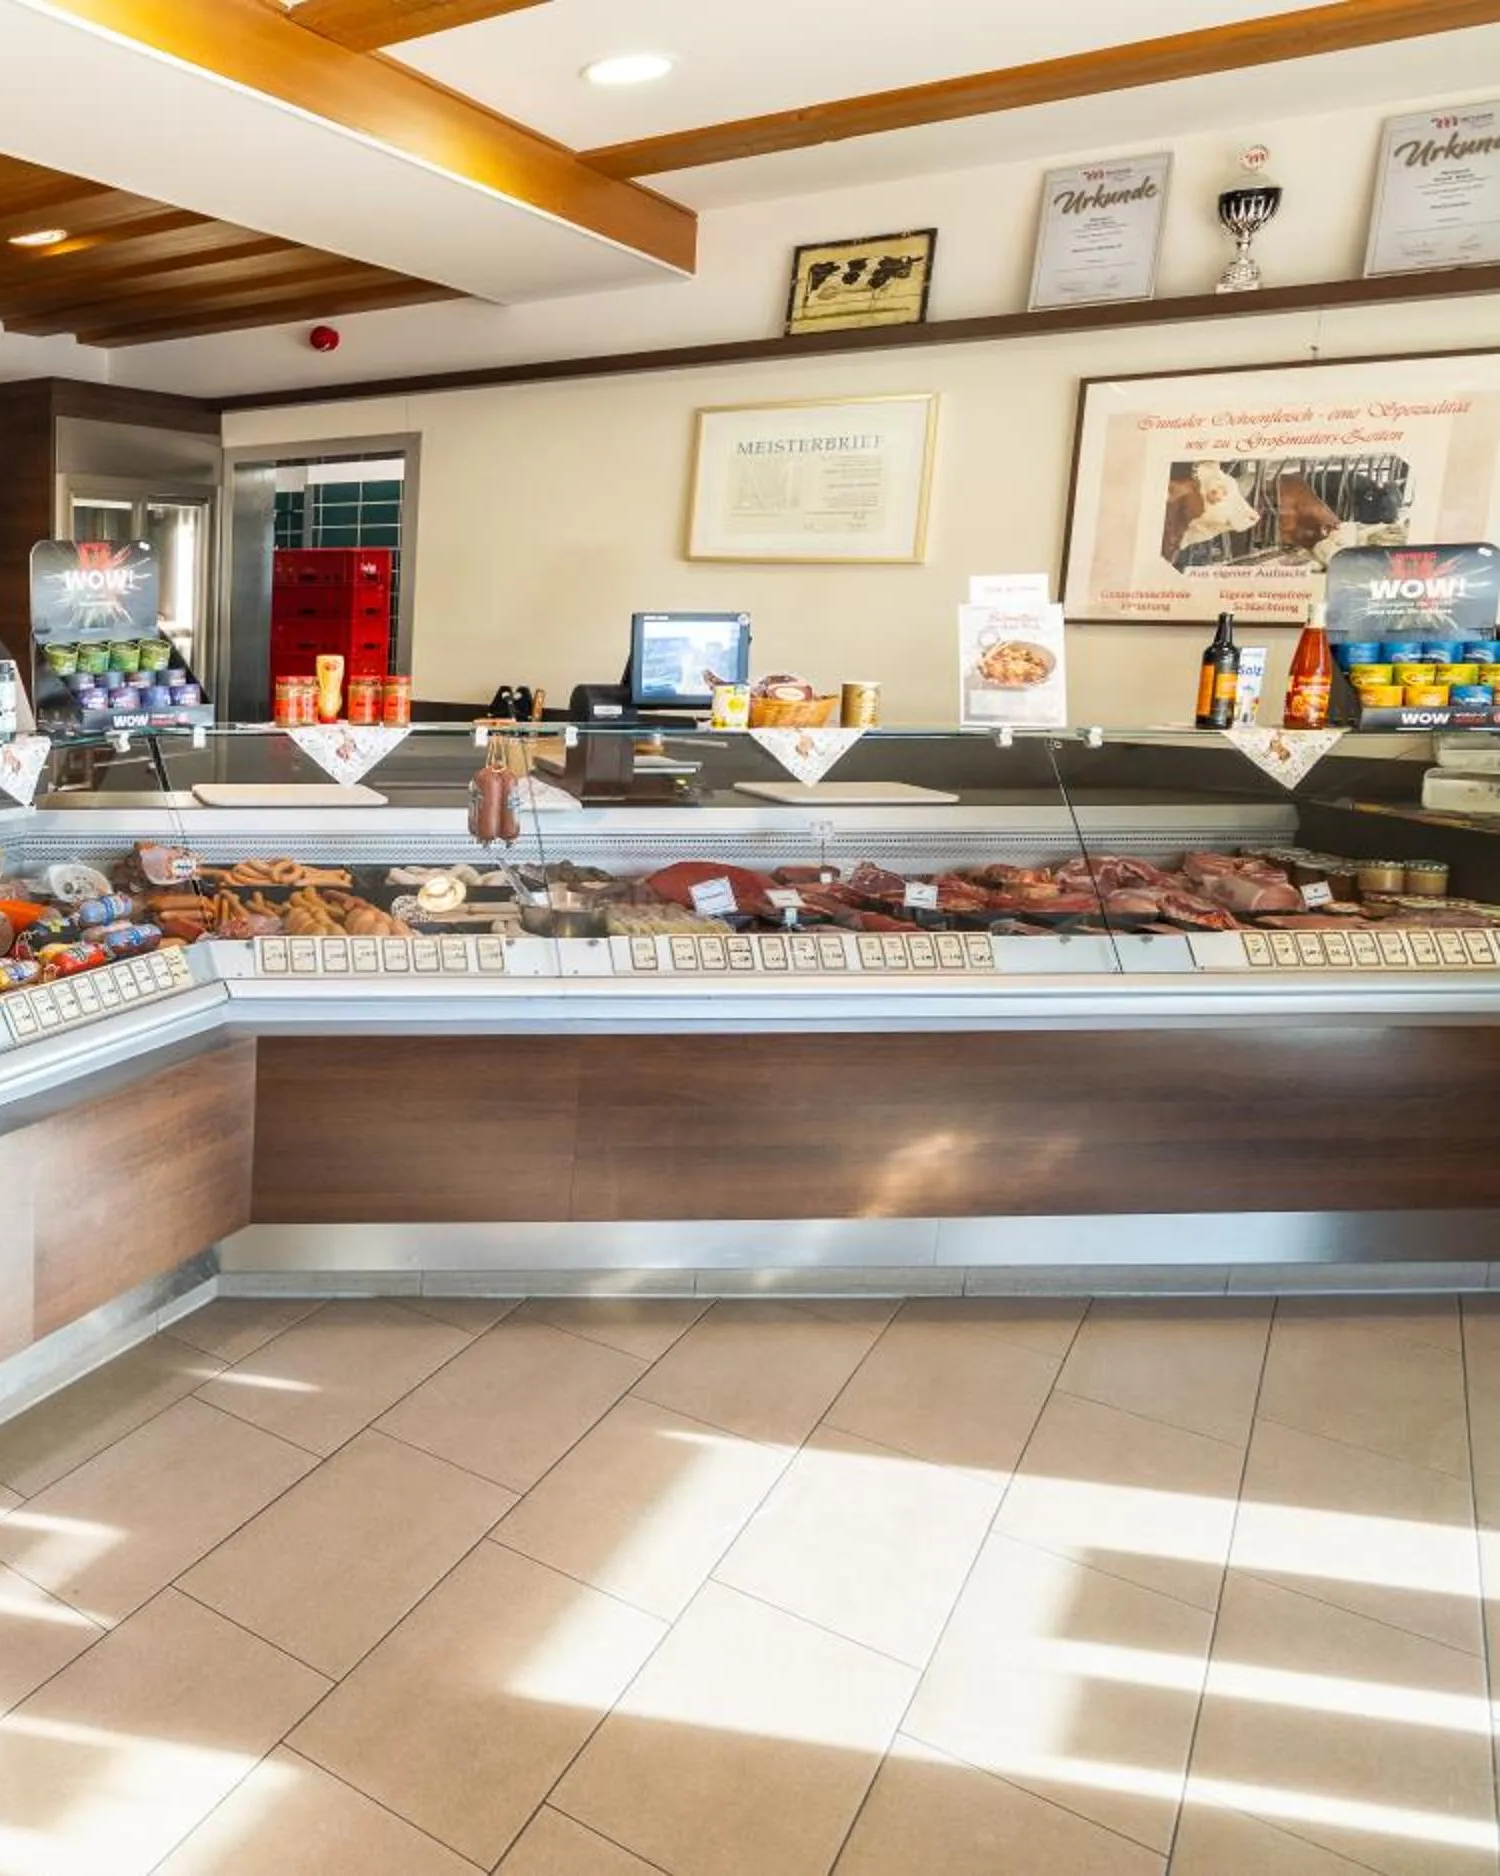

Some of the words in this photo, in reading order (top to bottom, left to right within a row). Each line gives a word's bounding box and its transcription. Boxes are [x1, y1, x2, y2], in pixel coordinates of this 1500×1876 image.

[1393, 131, 1500, 167] Urkun
[1053, 175, 1158, 215] Urkunde
[736, 434, 884, 457] MEISTERBRIEF
[65, 568, 135, 590] WOW!
[1369, 577, 1467, 600] WOW!
[113, 713, 149, 727] WOW
[1401, 711, 1451, 725] WOW
